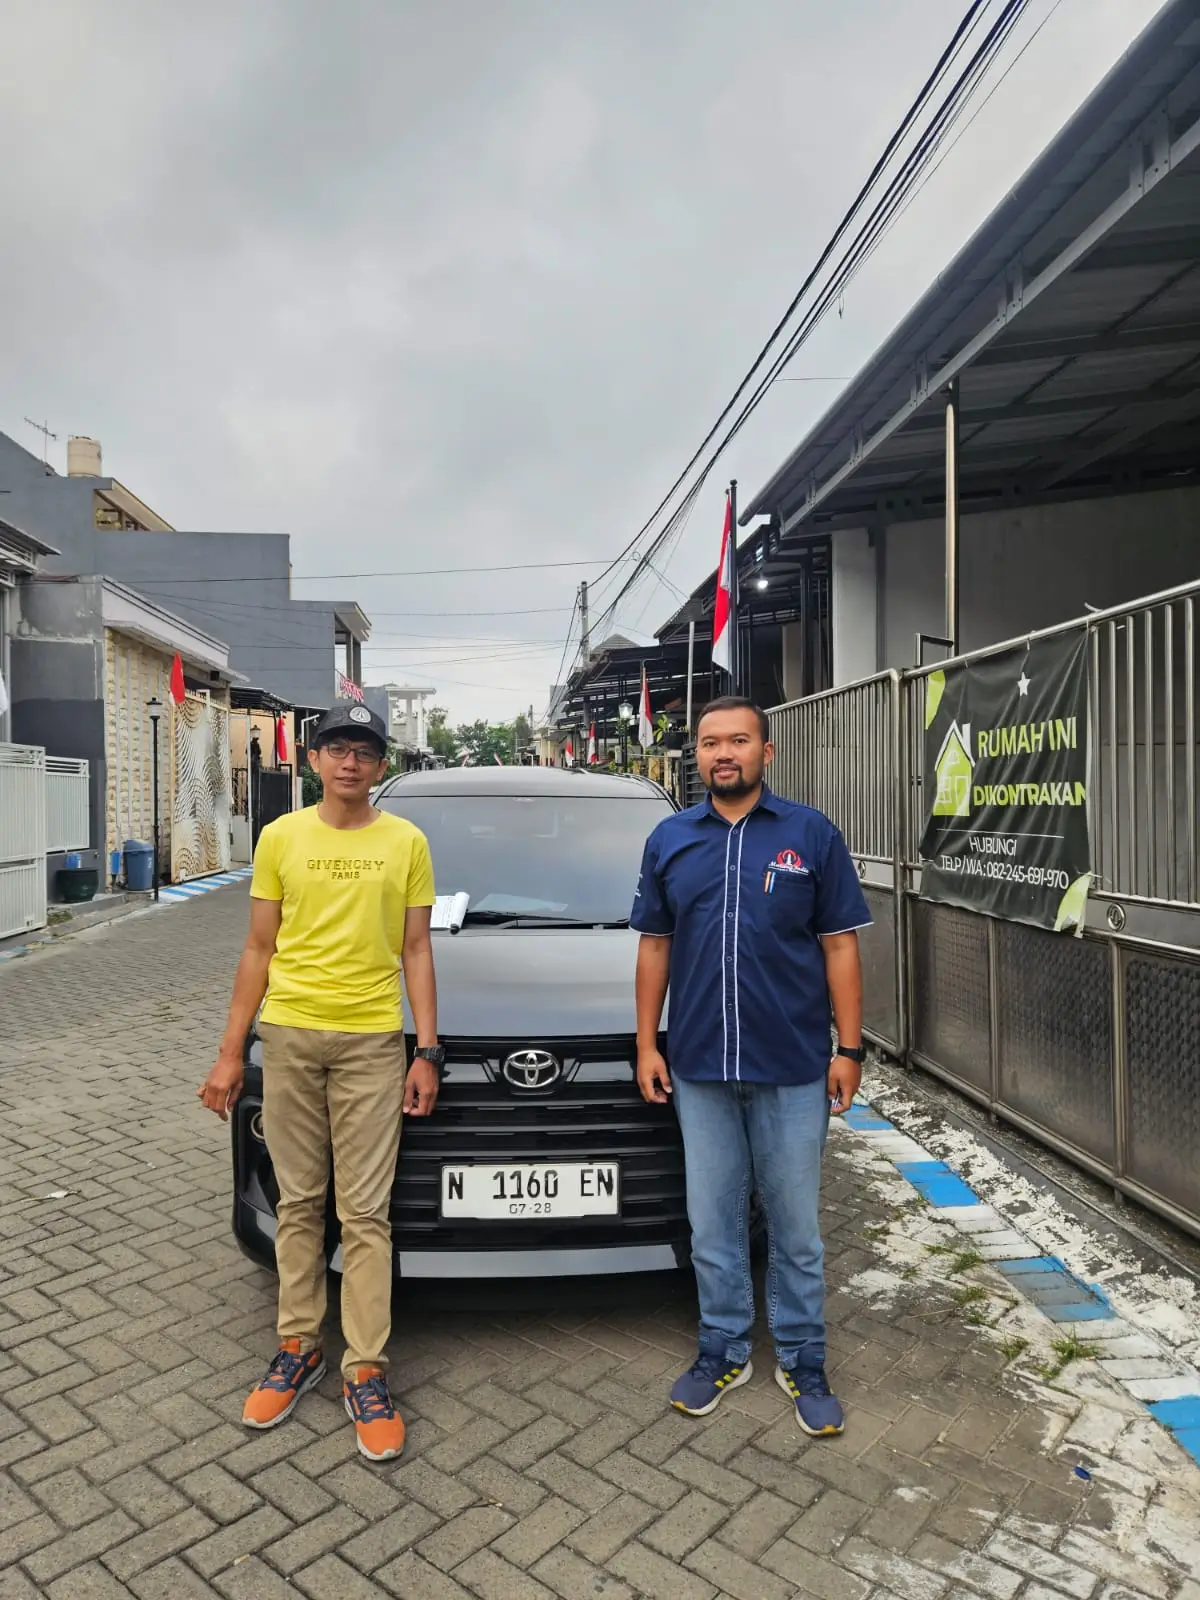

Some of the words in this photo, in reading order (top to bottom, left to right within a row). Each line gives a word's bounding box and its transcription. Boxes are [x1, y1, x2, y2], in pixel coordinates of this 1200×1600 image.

[978, 721, 1046, 758] RUMAH
[1048, 716, 1077, 751] INI
[973, 781, 1087, 806] DIKONTRAKAN
[968, 836, 1017, 856] HUBUNGI
[306, 859, 385, 871] GIVENCHY
[331, 871, 361, 880] PARIS
[448, 1171, 464, 1200] N
[493, 1169, 559, 1199] 1160
[580, 1168, 614, 1197] EN
